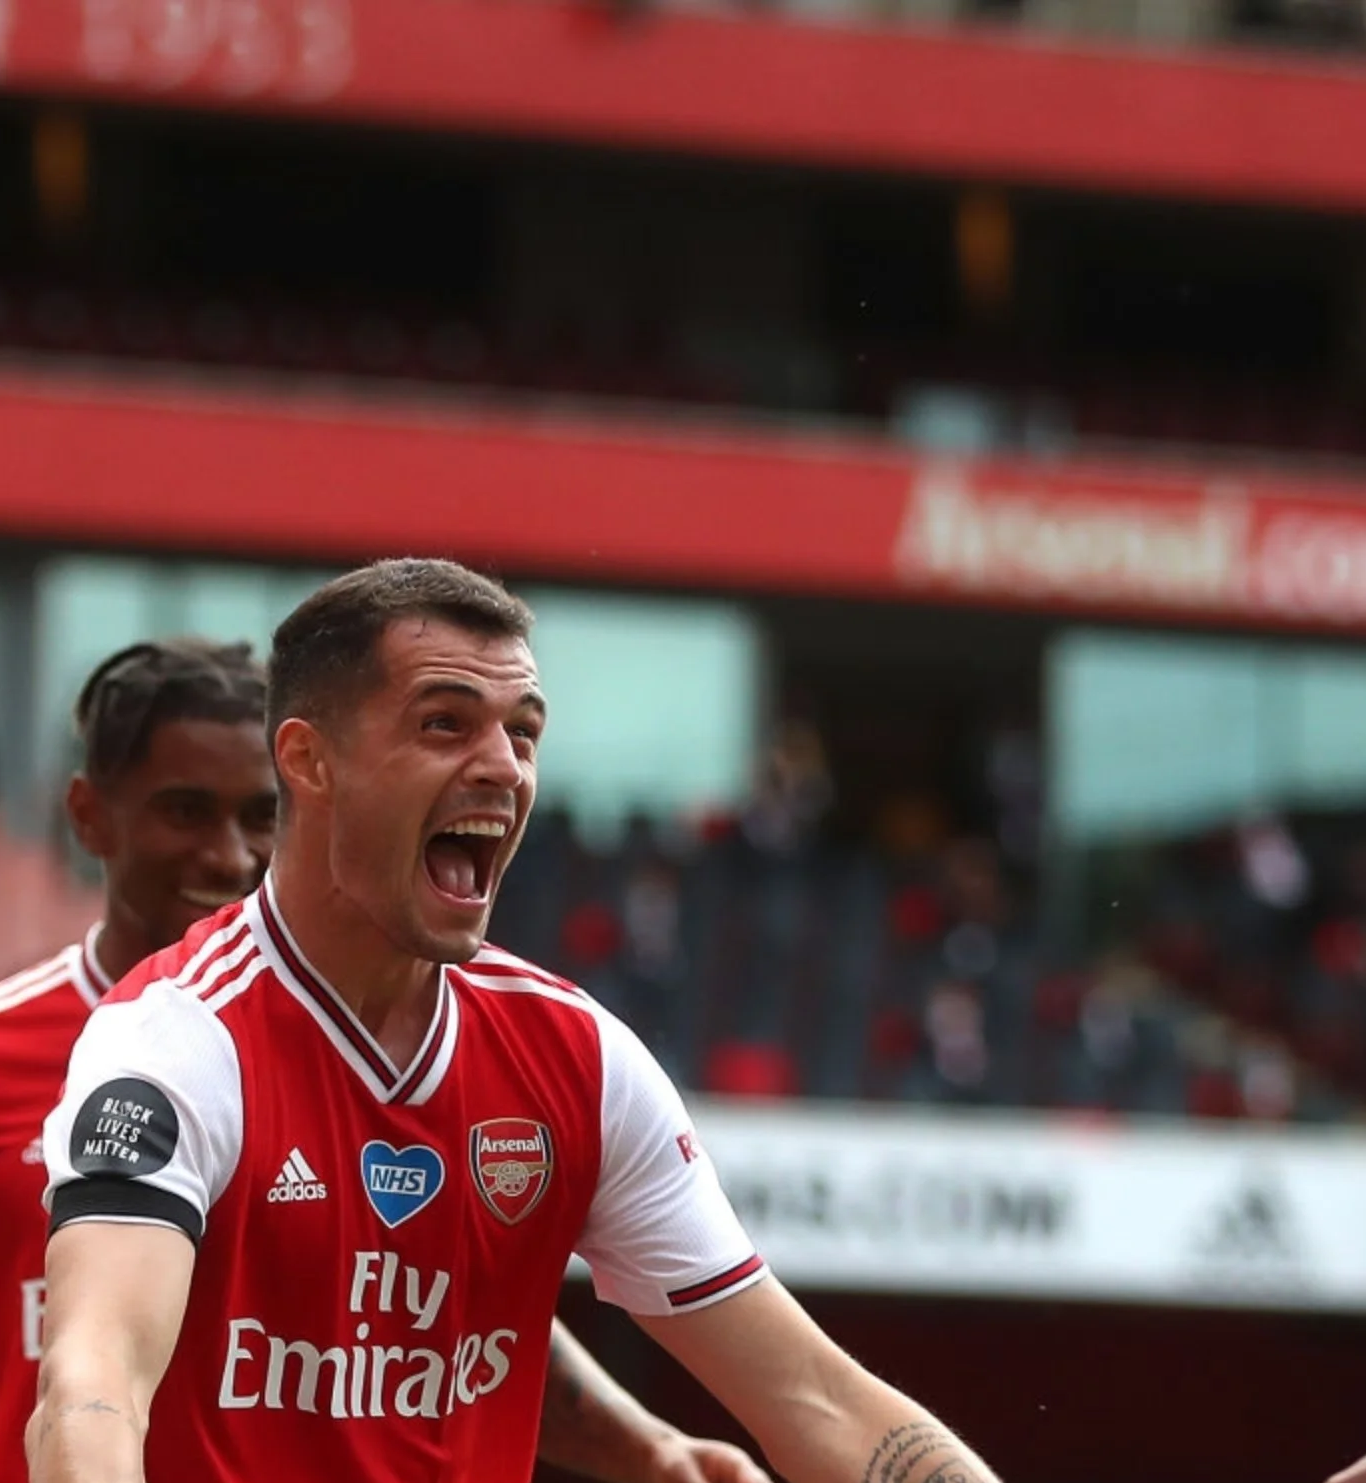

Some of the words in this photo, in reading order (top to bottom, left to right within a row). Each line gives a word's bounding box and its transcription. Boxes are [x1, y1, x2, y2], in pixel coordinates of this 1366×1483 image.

[96, 1118, 141, 1142] LIVES
[83, 1140, 140, 1163] MATTER
[481, 1136, 544, 1152] Arsenal
[267, 1181, 327, 1203] adidas
[372, 1168, 424, 1193] NHS
[349, 1251, 450, 1331] Fly
[218, 1318, 517, 1419] Emirates
